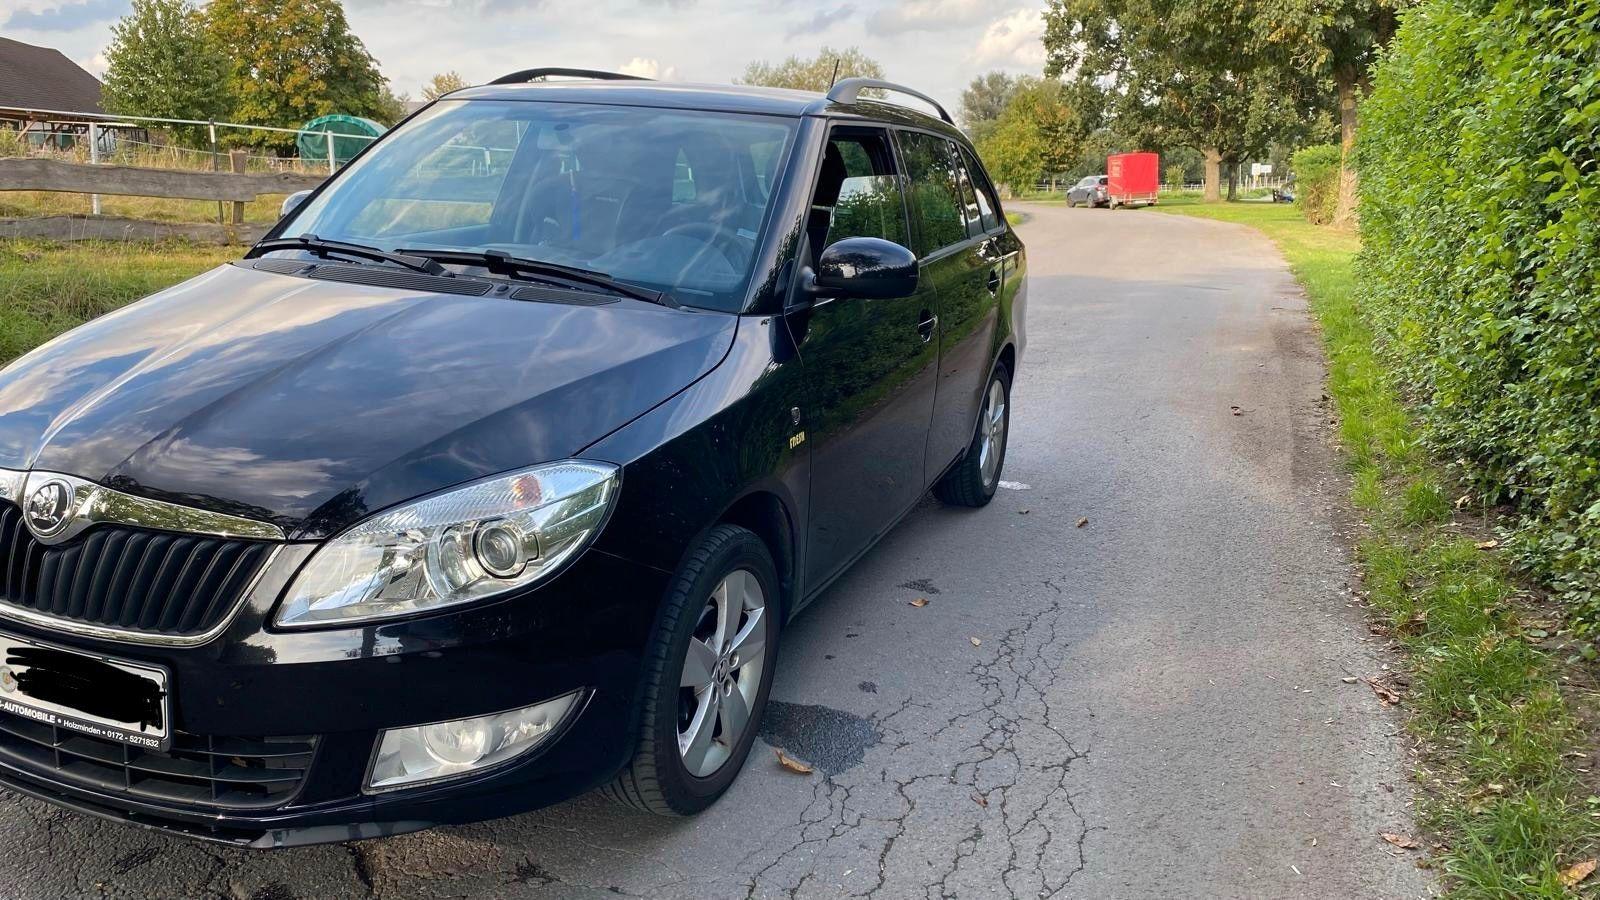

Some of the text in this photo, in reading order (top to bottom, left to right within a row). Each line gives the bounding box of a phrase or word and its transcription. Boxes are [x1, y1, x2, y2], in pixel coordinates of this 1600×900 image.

[63, 719, 101, 735] Holzminden
[107, 730, 124, 741] 0172
[129, 735, 159, 748] 5271832
